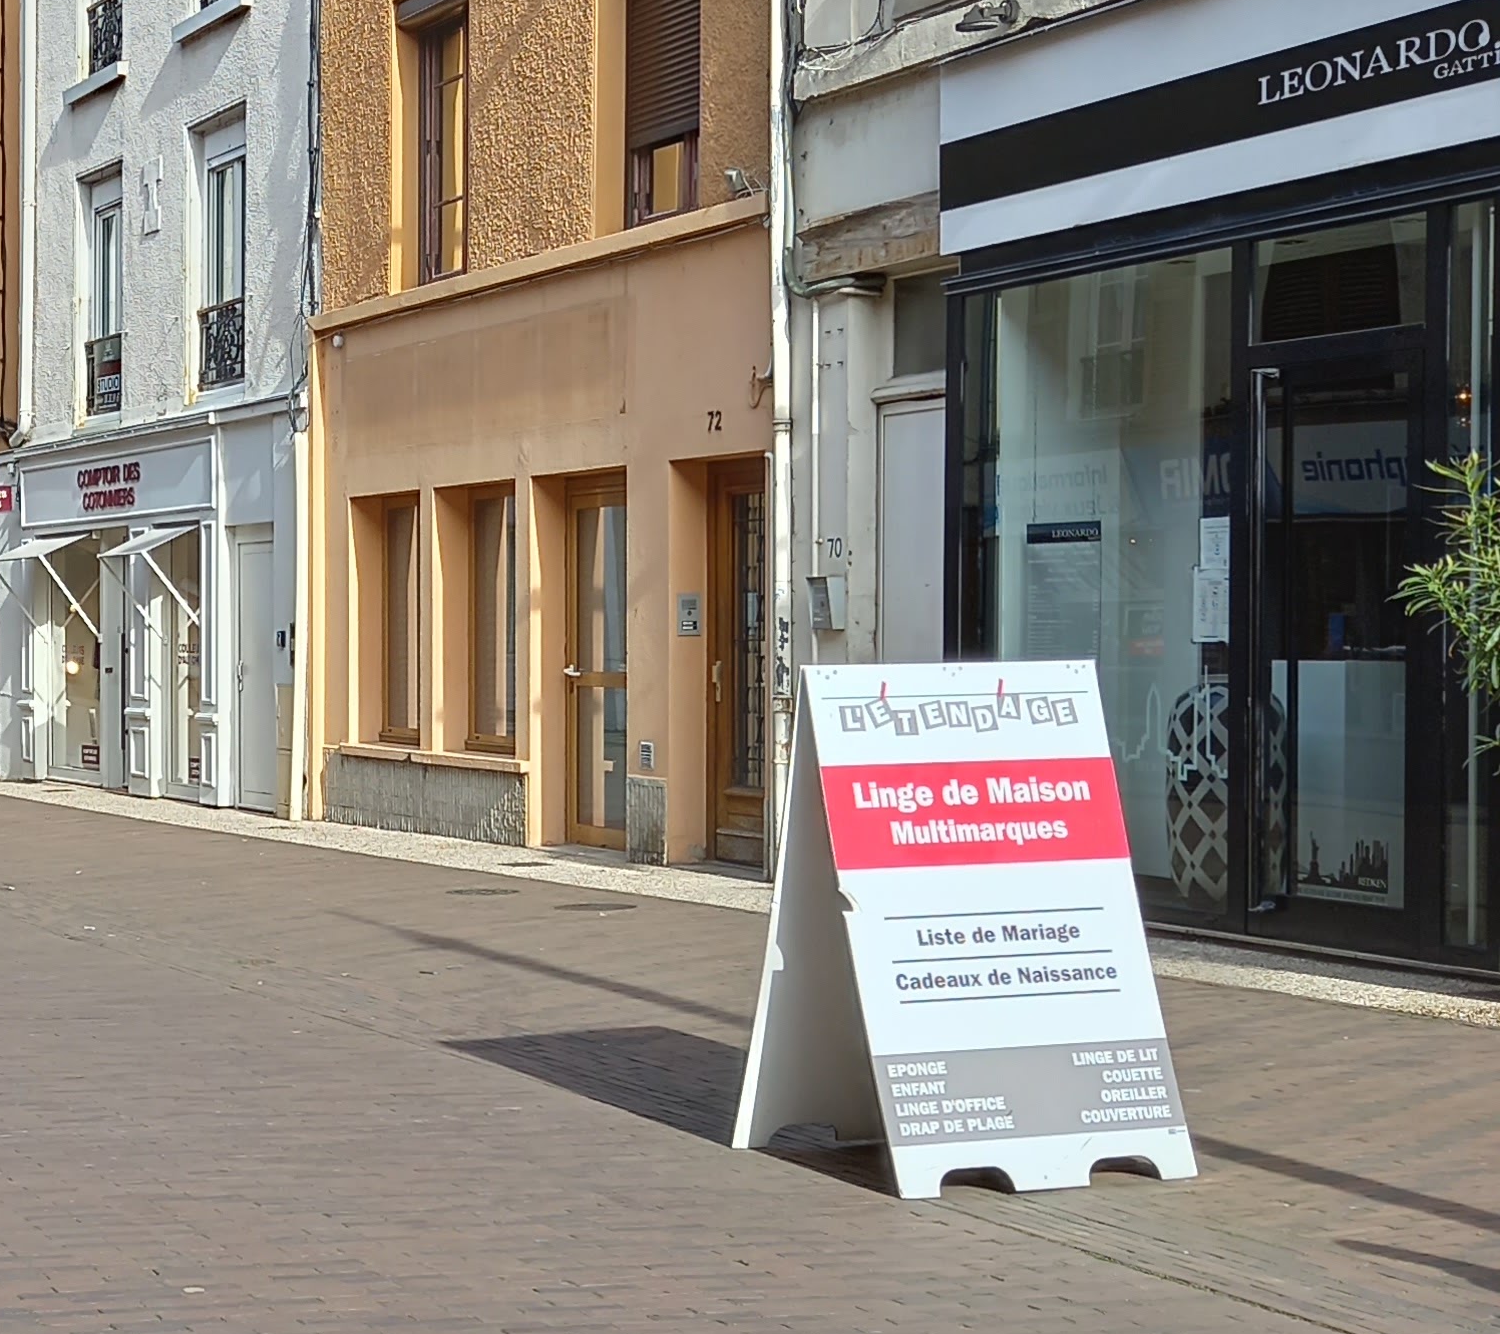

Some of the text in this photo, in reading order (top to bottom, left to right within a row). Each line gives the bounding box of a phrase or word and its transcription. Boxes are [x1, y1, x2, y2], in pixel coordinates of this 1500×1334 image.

[1258, 19, 1491, 105] LEONARDO
[707, 410, 722, 432] 72
[77, 462, 140, 489] COMPTOIR DES
[82, 487, 135, 512] COTONNIERS
[1051, 528, 1099, 539] LEONARDO
[827, 537, 842, 558] 70
[853, 775, 1090, 815] Linge de Maison
[891, 818, 1068, 848] Multimarques
[916, 923, 1080, 948] Liste de Mariage
[895, 964, 1118, 992] Cadeaux de Naissance
[1072, 1048, 1158, 1067] LINGE DE LIT
[887, 1061, 947, 1079] EPONGE
[1102, 1067, 1164, 1083] COUETTE
[891, 1081, 946, 1097] ENFANT
[1100, 1085, 1167, 1102] OREILLER
[895, 1096, 1006, 1117] LINGE D'OFFICE
[1080, 1104, 1171, 1124] COUVERTURE
[899, 1119, 940, 1136] DRAP
[943, 1118, 965, 1134] DE
